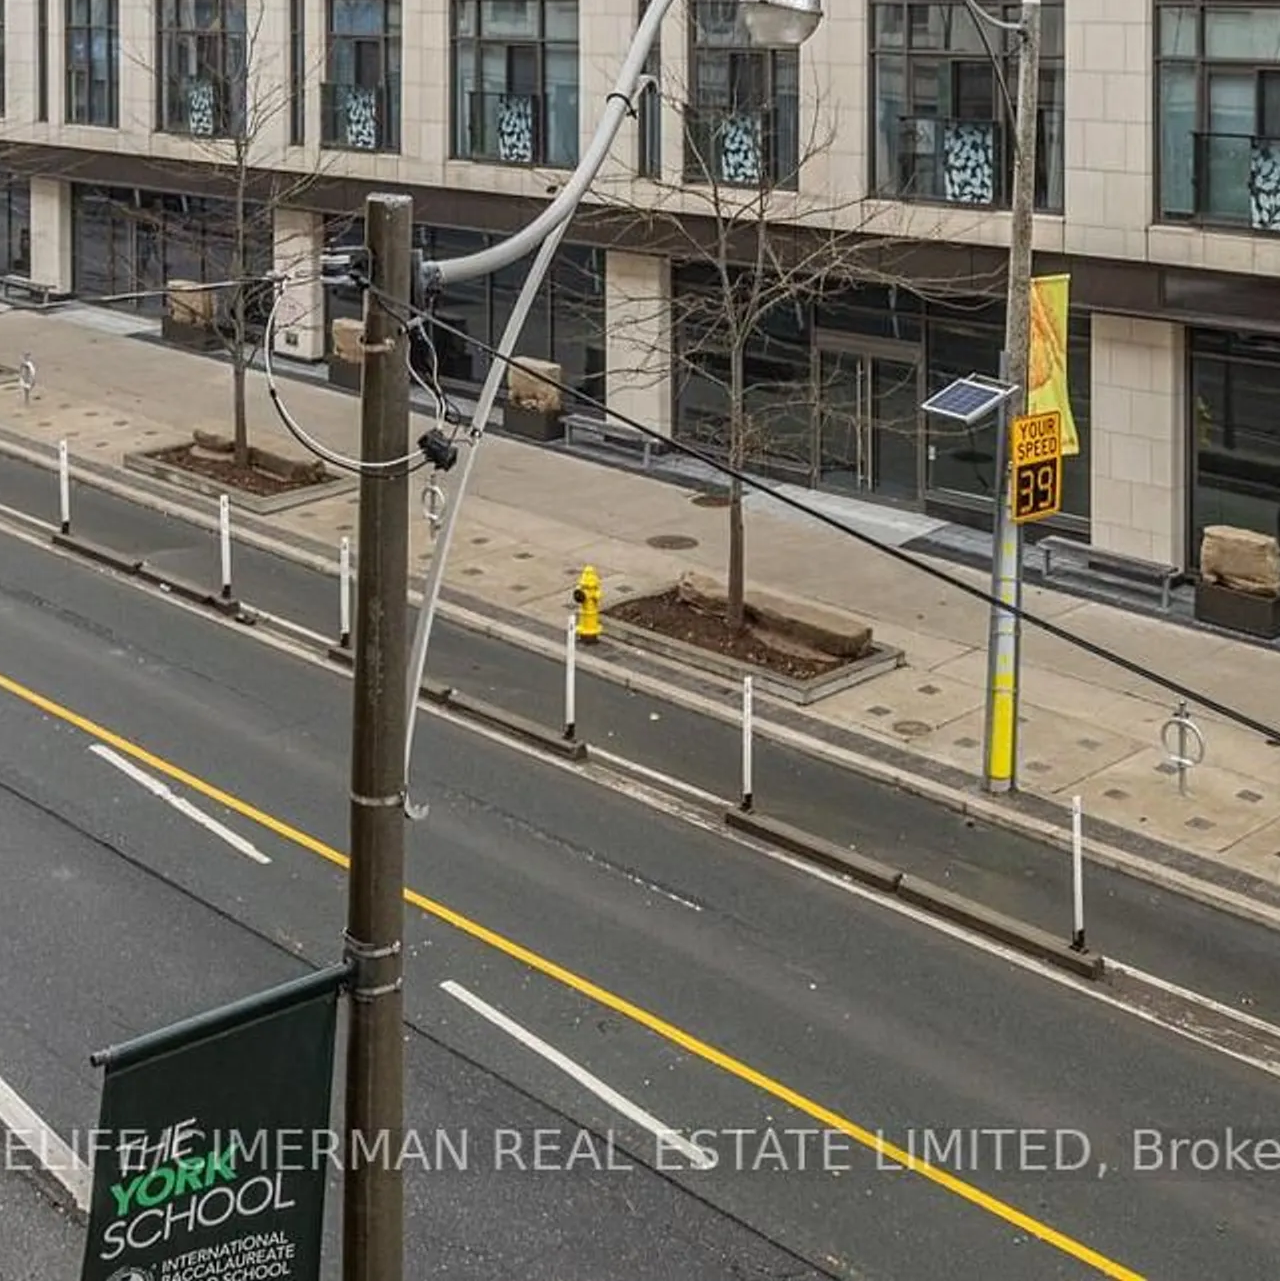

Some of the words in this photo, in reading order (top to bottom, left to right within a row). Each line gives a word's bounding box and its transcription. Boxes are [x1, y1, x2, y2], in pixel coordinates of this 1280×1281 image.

[1018, 437, 1057, 460] SPEED
[1020, 418, 1055, 439] YOUR
[1020, 466, 1053, 514] 39
[115, 1117, 197, 1177] THE
[110, 1143, 238, 1216] YORK
[100, 1172, 296, 1260] SCHOOL
[161, 1230, 290, 1274] INTERNATIONAL
